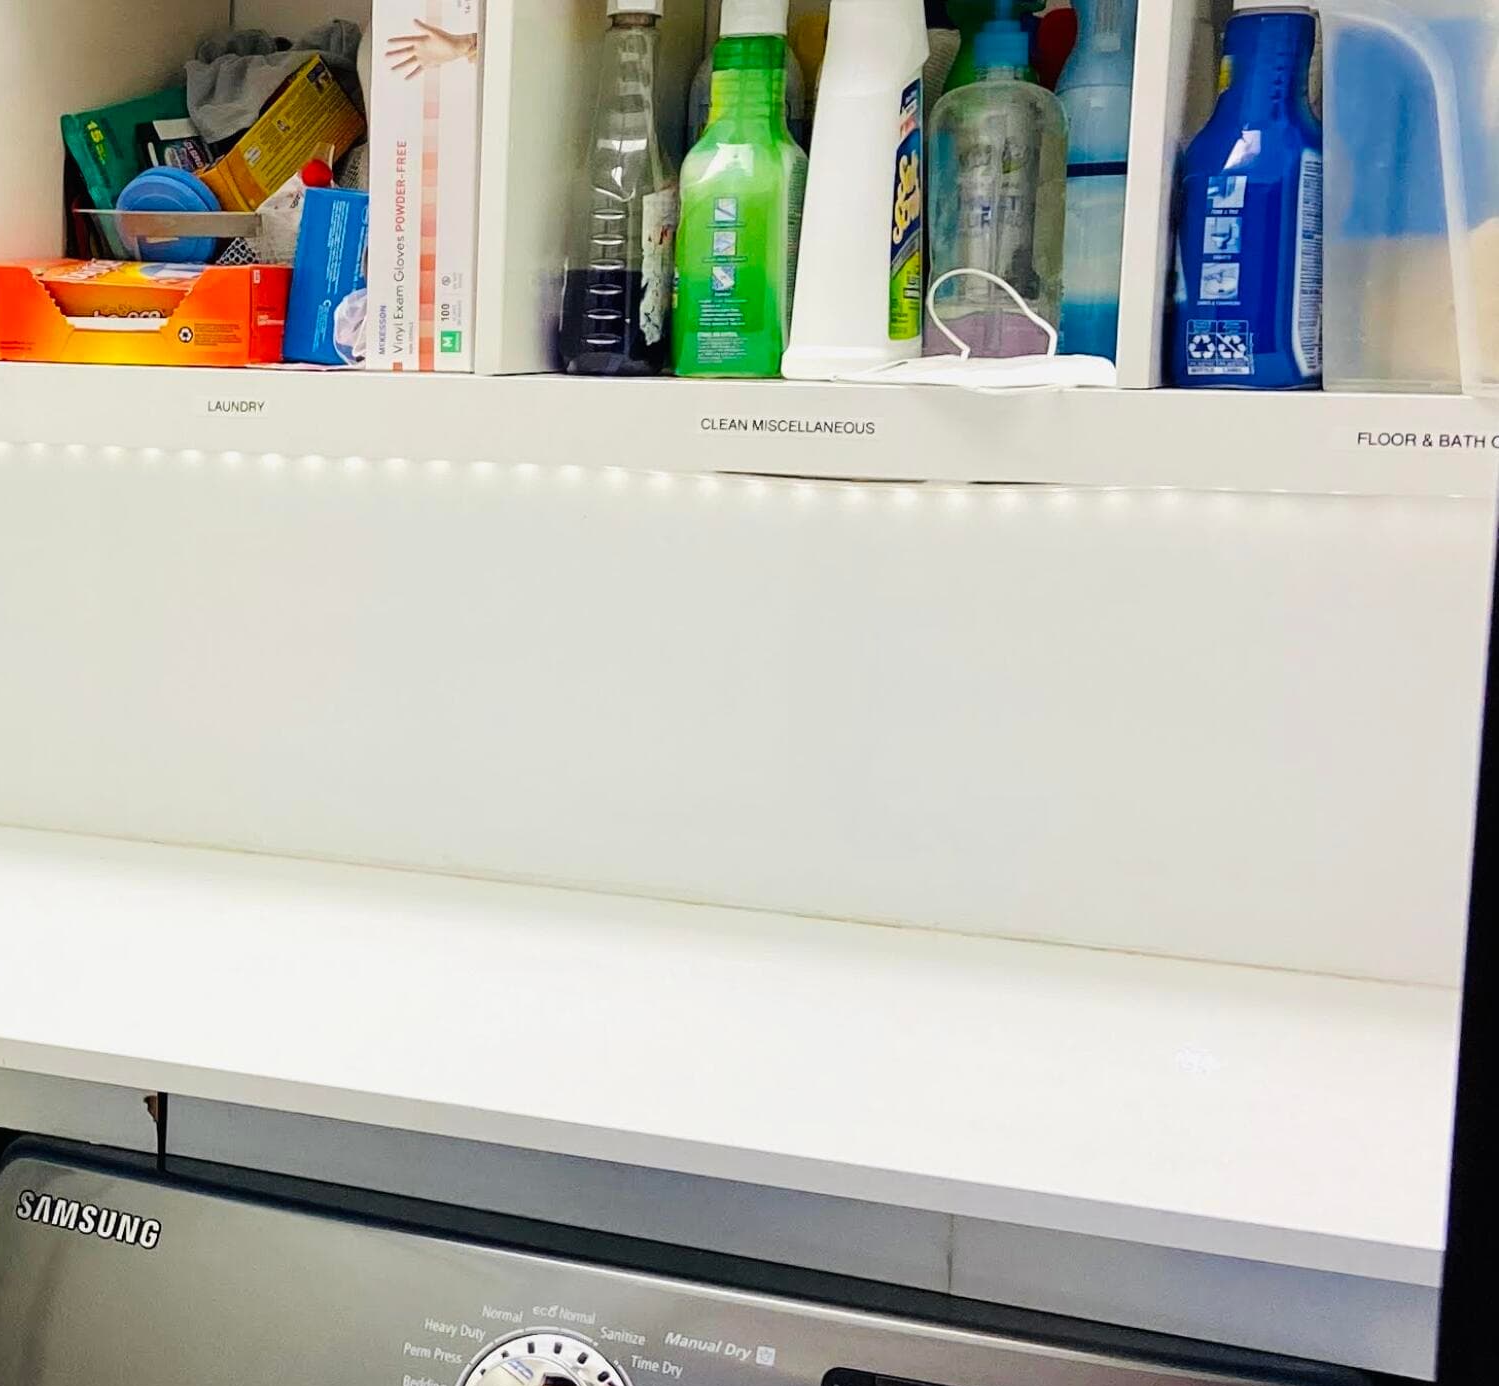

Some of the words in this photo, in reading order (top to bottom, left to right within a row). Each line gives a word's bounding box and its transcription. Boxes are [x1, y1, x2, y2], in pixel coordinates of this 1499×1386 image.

[395, 141, 407, 232] POWDER-FREE
[393, 236, 405, 281] Gloves
[393, 285, 404, 319] Exam
[441, 304, 450, 321] 100
[393, 323, 406, 354] Vinyl
[442, 336, 453, 348] M
[207, 401, 265, 413] LAUNDRY
[700, 418, 748, 431] CLEAN
[752, 419, 875, 435] MISCELLANEOUS
[1357, 432, 1416, 446] FLOOR
[1422, 433, 1432, 447] &
[1439, 434, 1485, 448] BATH
[16, 1190, 161, 1249] SAMSUNG
[482, 1305, 523, 1323] Normal
[559, 1307, 596, 1325] Normal
[424, 1318, 457, 1338] Heavy
[460, 1324, 486, 1343] Duty
[600, 1326, 646, 1346] Sanitize
[403, 1342, 432, 1358] Perm
[434, 1347, 463, 1364] Press
[664, 1332, 720, 1353] Manual
[724, 1345, 753, 1361] Dry
[630, 1354, 660, 1372] Time
[662, 1360, 684, 1379] Dry
